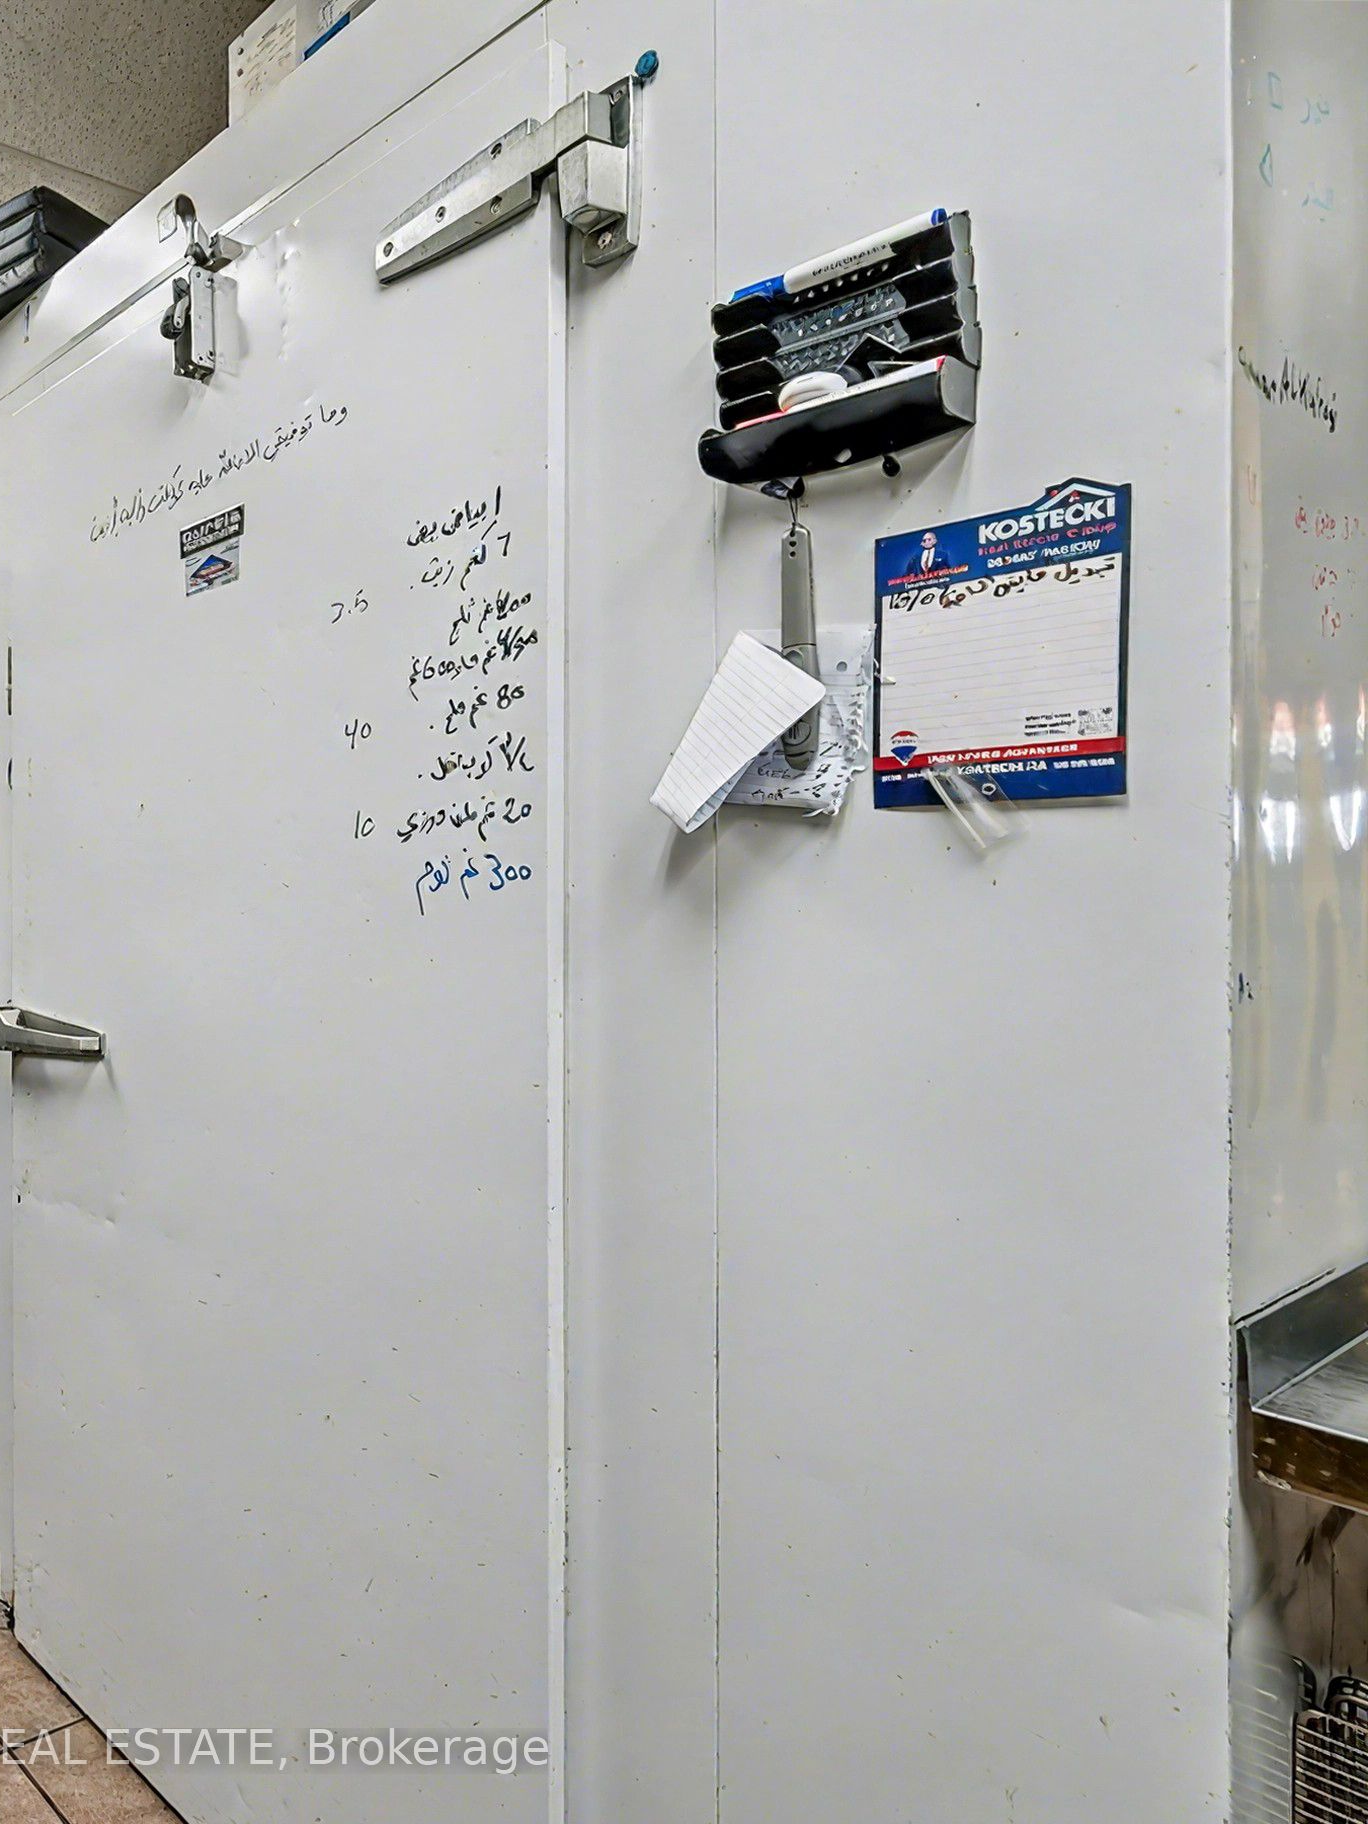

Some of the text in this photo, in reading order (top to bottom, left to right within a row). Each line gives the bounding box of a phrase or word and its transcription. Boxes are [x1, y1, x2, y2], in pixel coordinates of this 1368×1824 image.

[978, 496, 1116, 544] KOSTECKI
[496, 683, 526, 709] 80
[345, 718, 371, 749] 40
[354, 810, 375, 839] 10
[503, 796, 533, 824] 20
[484, 854, 533, 891] 300
